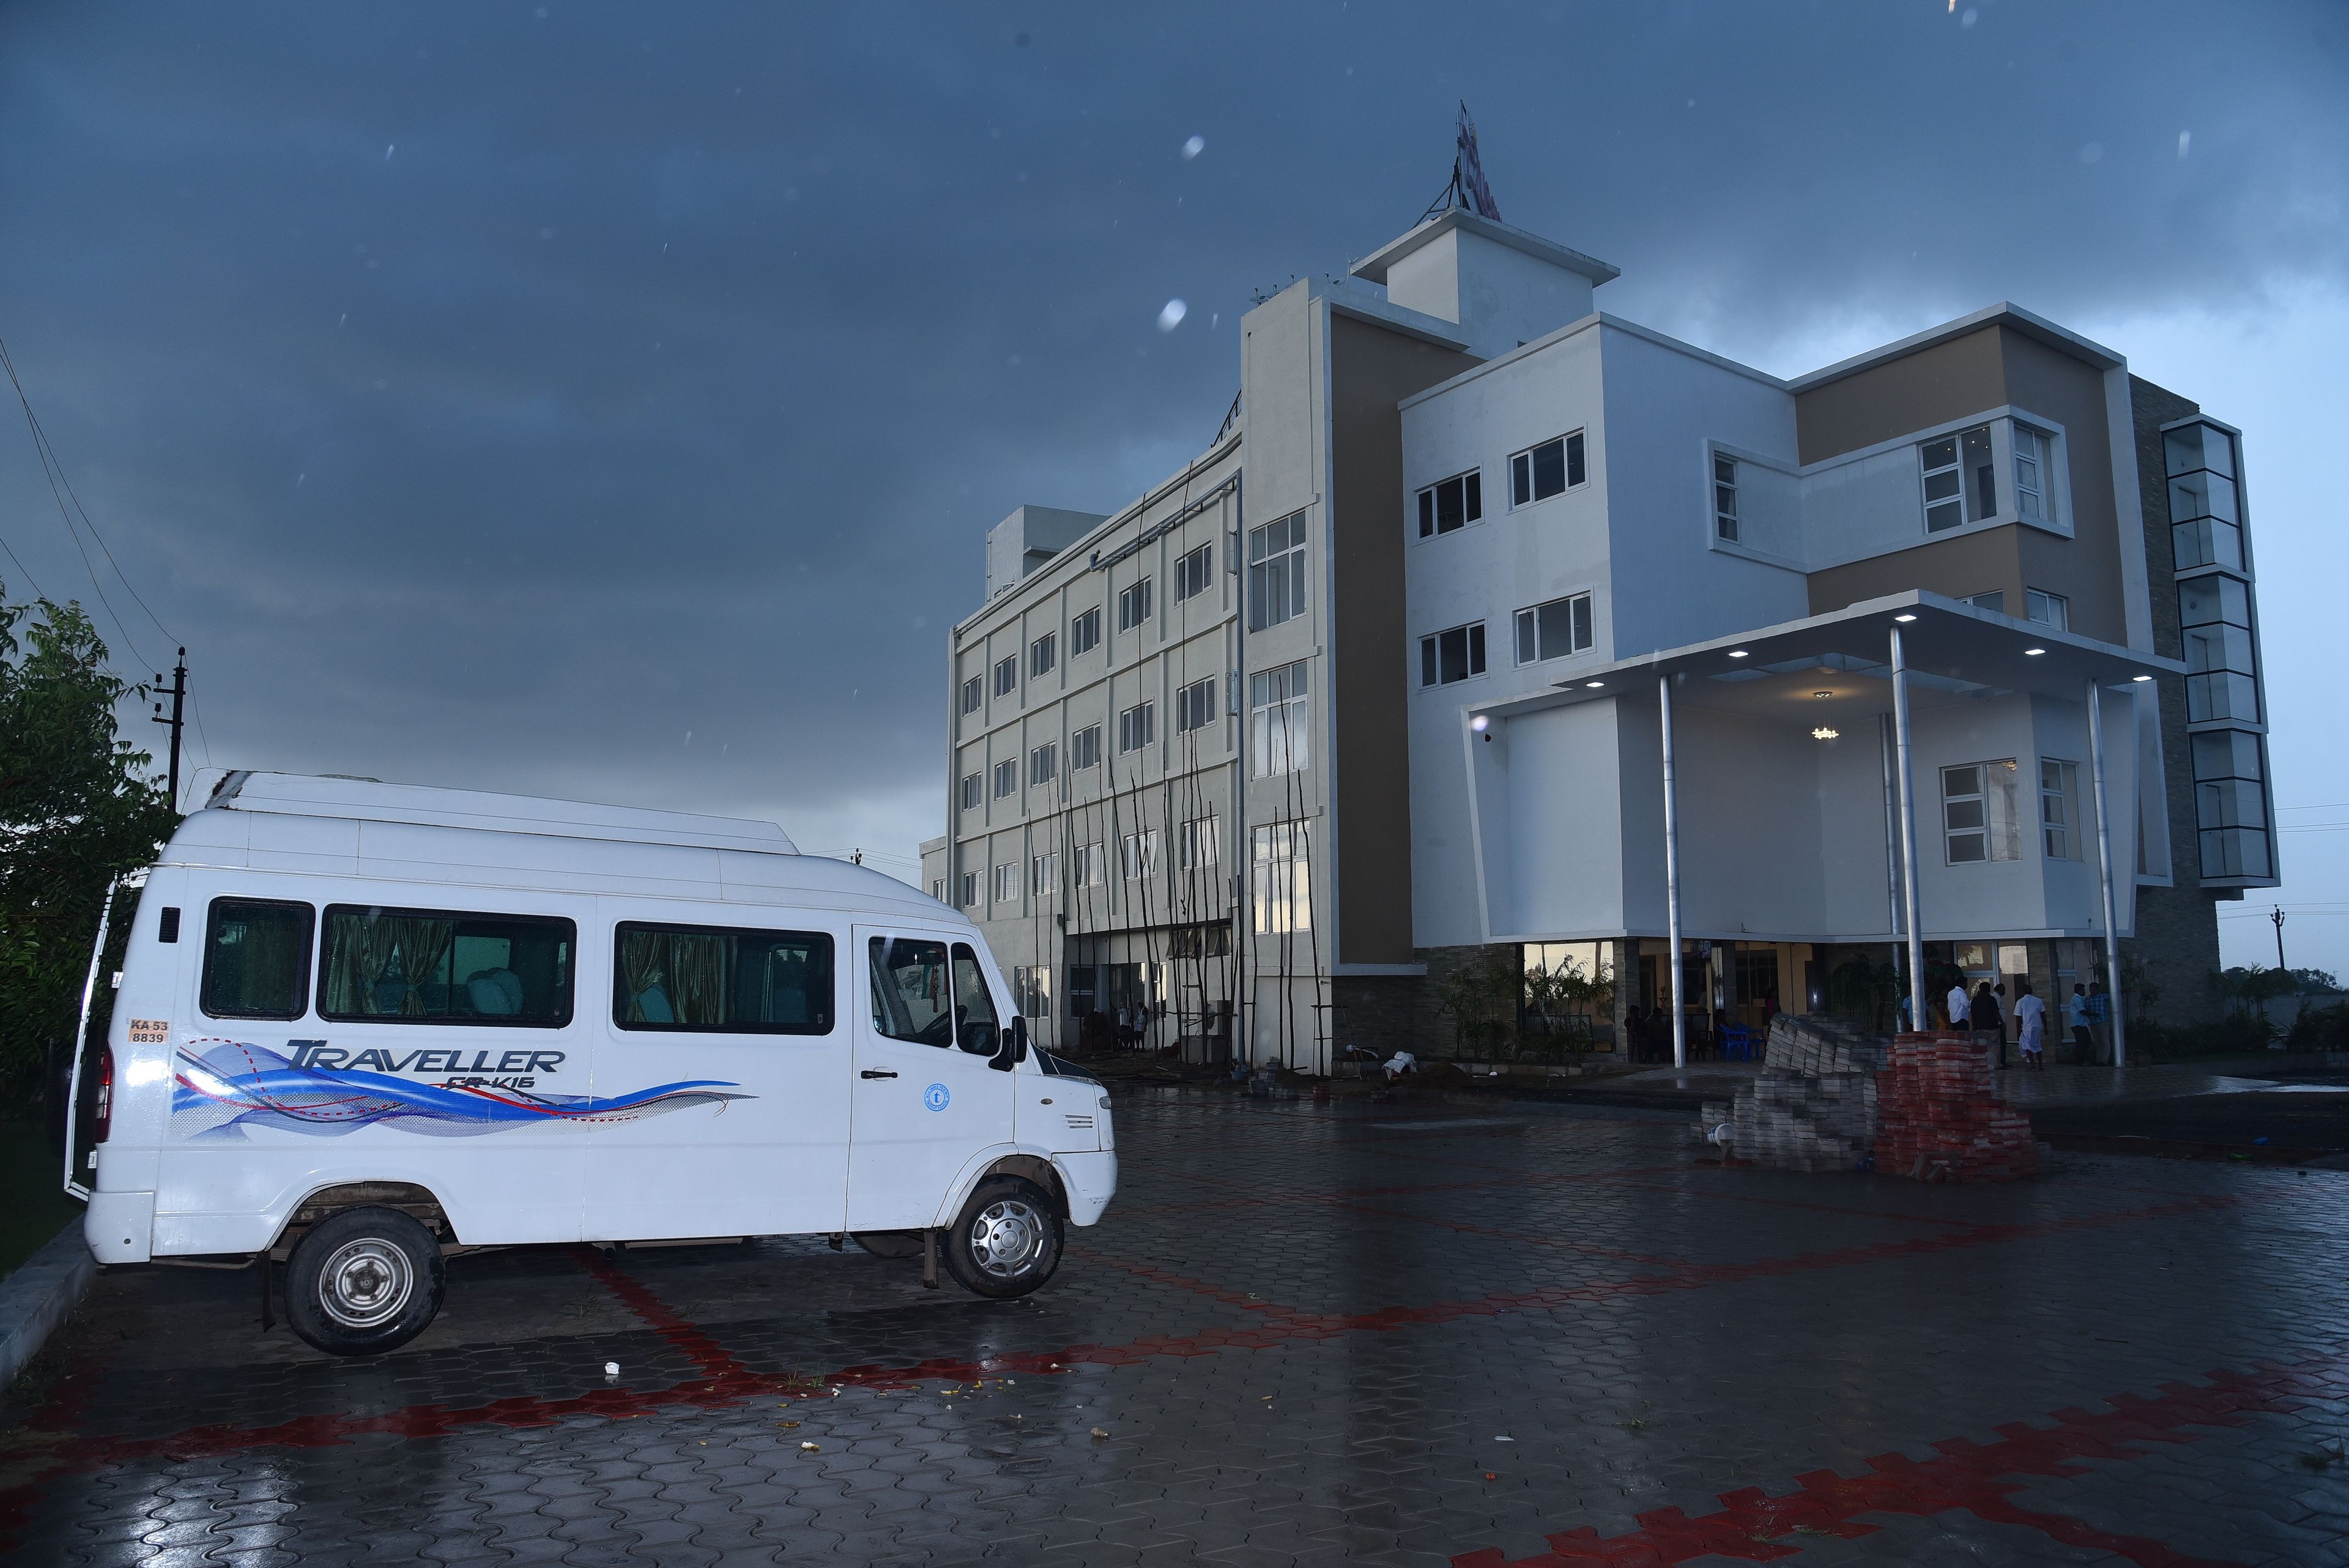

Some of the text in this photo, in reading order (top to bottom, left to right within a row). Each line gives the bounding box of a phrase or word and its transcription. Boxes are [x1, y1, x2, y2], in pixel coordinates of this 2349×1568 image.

[130, 1020, 168, 1031] KA 53
[132, 1033, 164, 1043] 8839
[286, 1039, 566, 1073] TRAVELLER
